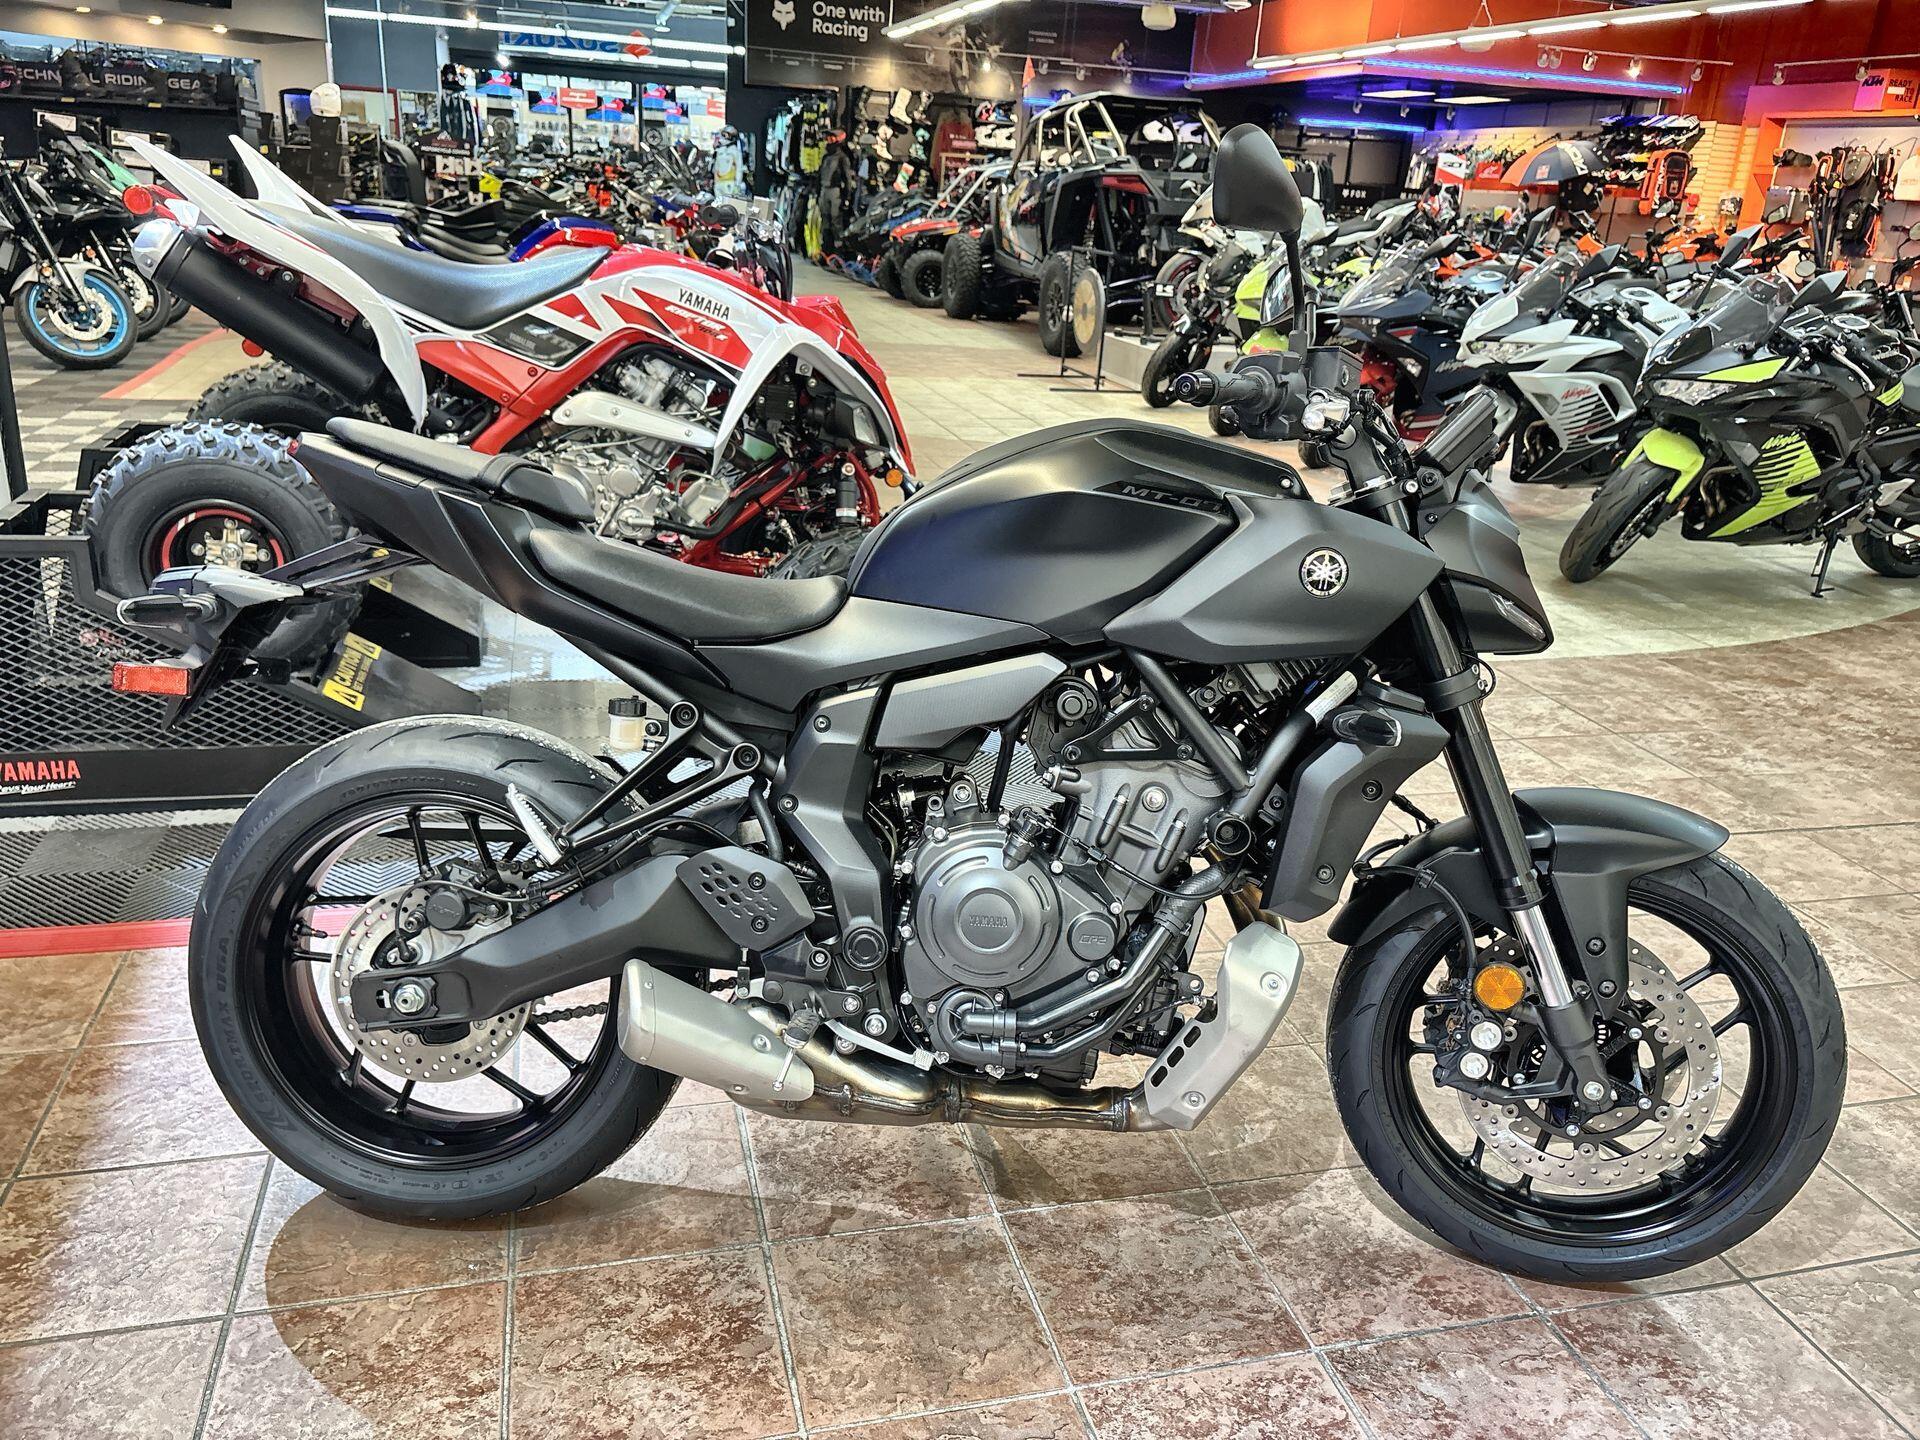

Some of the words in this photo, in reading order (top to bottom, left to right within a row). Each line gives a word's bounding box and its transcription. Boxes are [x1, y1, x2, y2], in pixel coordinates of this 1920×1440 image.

[813, 1, 846, 18] One
[849, 6, 885, 22] with
[813, 18, 868, 42] Racing
[105, 73, 147, 87] RIDIN
[168, 78, 201, 90] GEA
[1350, 189, 1367, 199] FOX
[678, 288, 730, 321] YAMAHA
[1560, 384, 1593, 400] Ninja
[1761, 430, 1802, 451] Ninja
[1122, 485, 1222, 513] MT-07
[332, 646, 363, 687] CAUTION
[0, 759, 81, 782] AMAHA
[21, 783, 46, 795] Your
[969, 914, 1009, 929] YAMAHA
